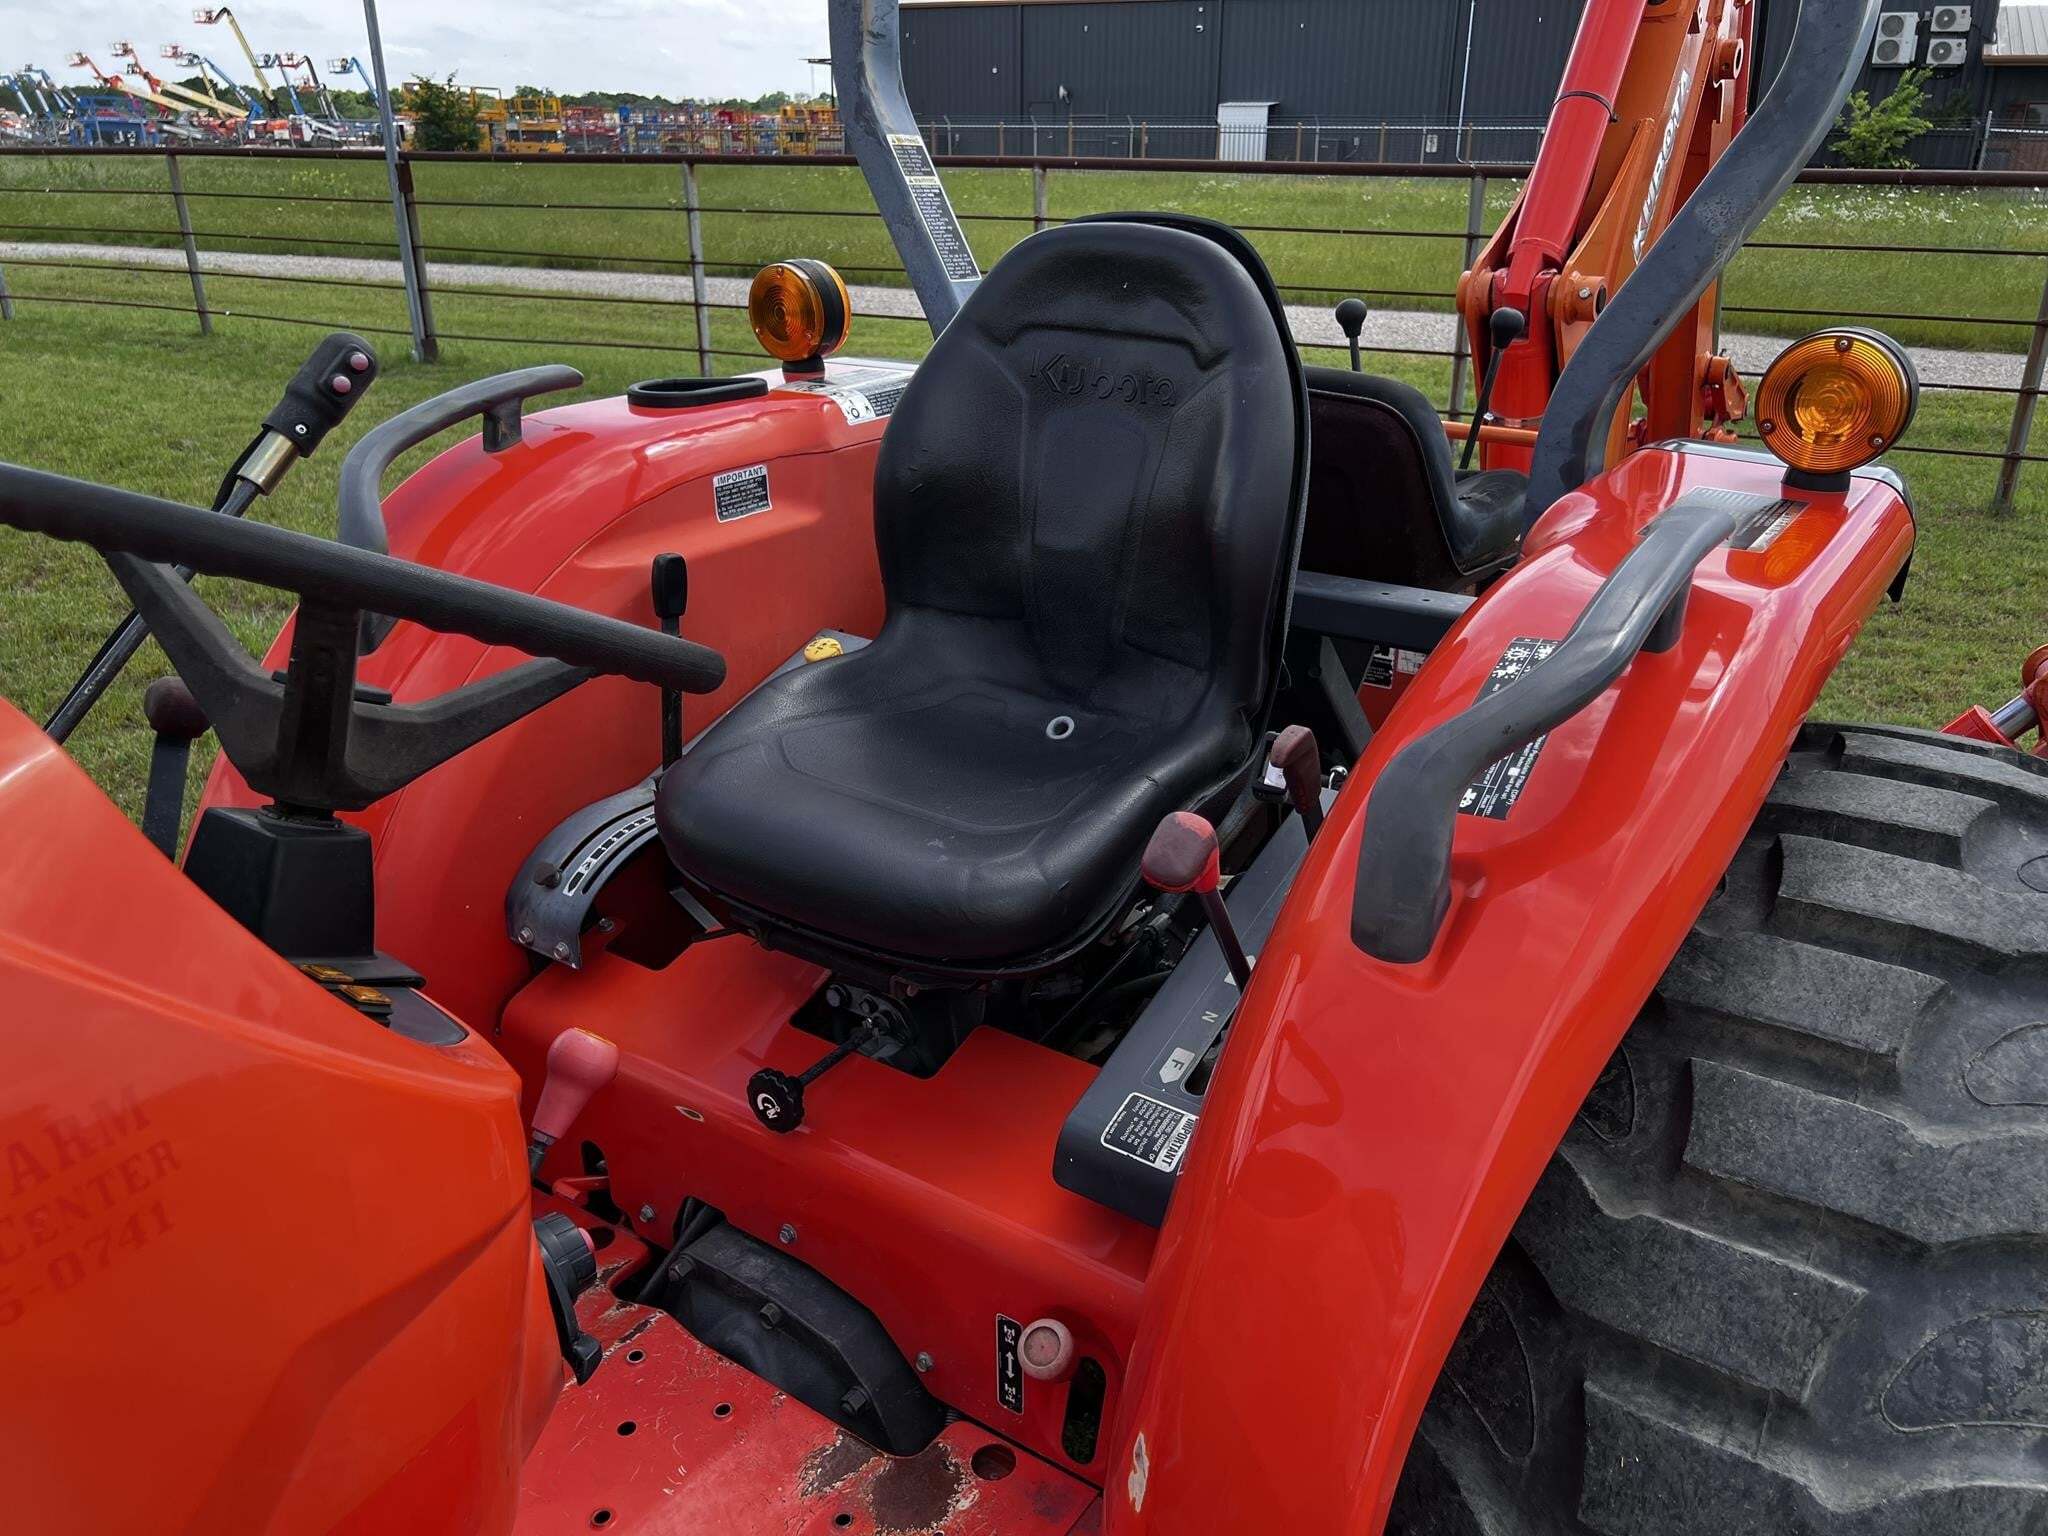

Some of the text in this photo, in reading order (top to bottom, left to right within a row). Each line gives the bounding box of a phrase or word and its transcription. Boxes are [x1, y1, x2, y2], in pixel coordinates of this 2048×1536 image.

[717, 467, 764, 485] IMPORTANT
[1202, 1011, 1219, 1023] N
[1172, 1059, 1185, 1071] F
[1161, 1118, 1195, 1167] IMPORTANT
